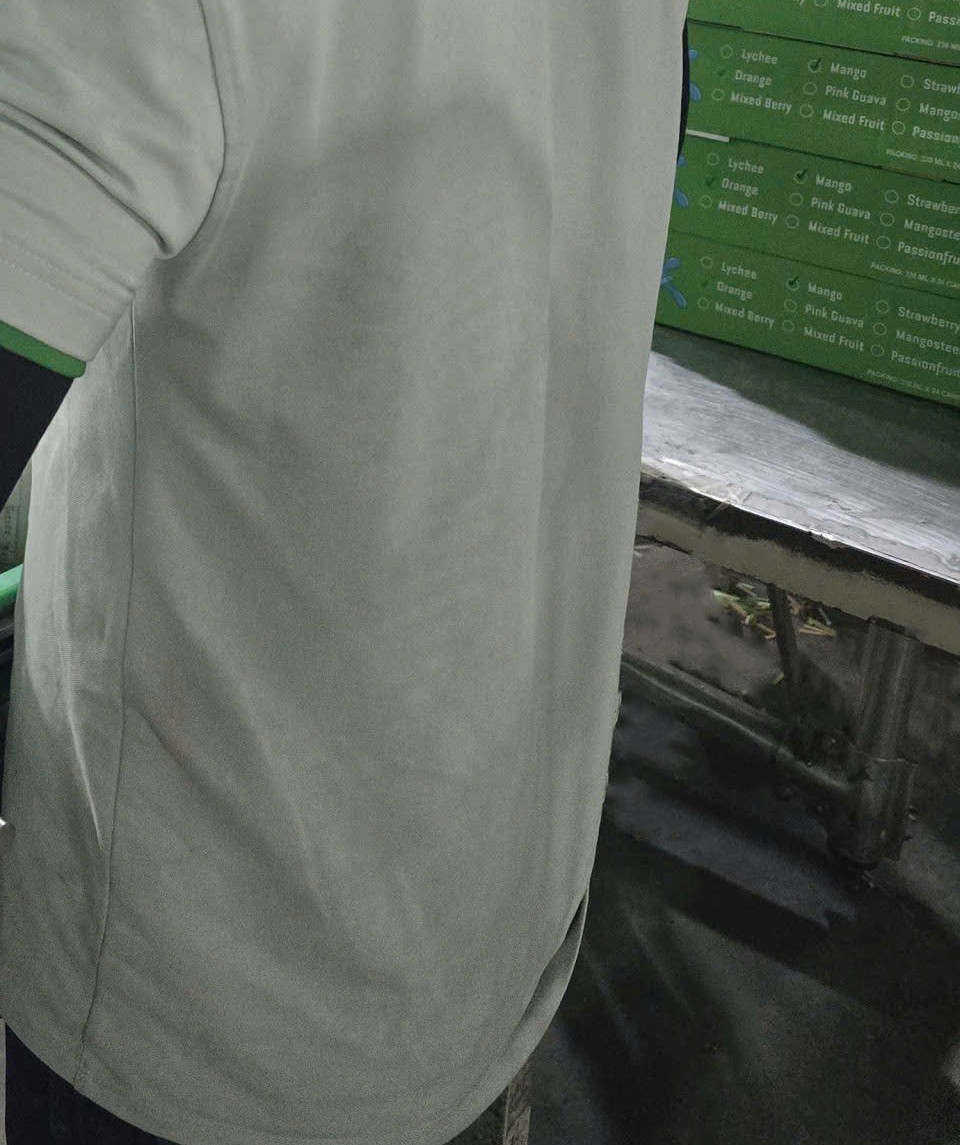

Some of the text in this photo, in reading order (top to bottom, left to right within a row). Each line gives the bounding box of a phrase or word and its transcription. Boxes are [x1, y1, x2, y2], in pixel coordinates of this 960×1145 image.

[873, 3, 901, 18] Fruit
[740, 48, 778, 65] Lychee
[735, 70, 773, 87] Orange
[830, 62, 867, 81] Mango
[730, 91, 792, 115] Mixed Berry
[825, 85, 887, 106] Pink Guava
[822, 109, 885, 131] Mixed Fruit
[728, 157, 765, 175] Lychee
[721, 177, 759, 197] Orange
[815, 174, 852, 194] Mango
[718, 199, 778, 224] Mixed Berry
[810, 197, 872, 220] Pink Guava
[808, 221, 870, 245] Mixed Fruit
[721, 261, 758, 280] Lychee
[716, 281, 753, 301] Orange
[807, 283, 843, 302] Mango
[714, 302, 775, 329] Mixed Berry
[804, 304, 865, 328] Pink Guava
[898, 306, 960, 334] Strawberry
[803, 326, 865, 352] Mixed Fruit
